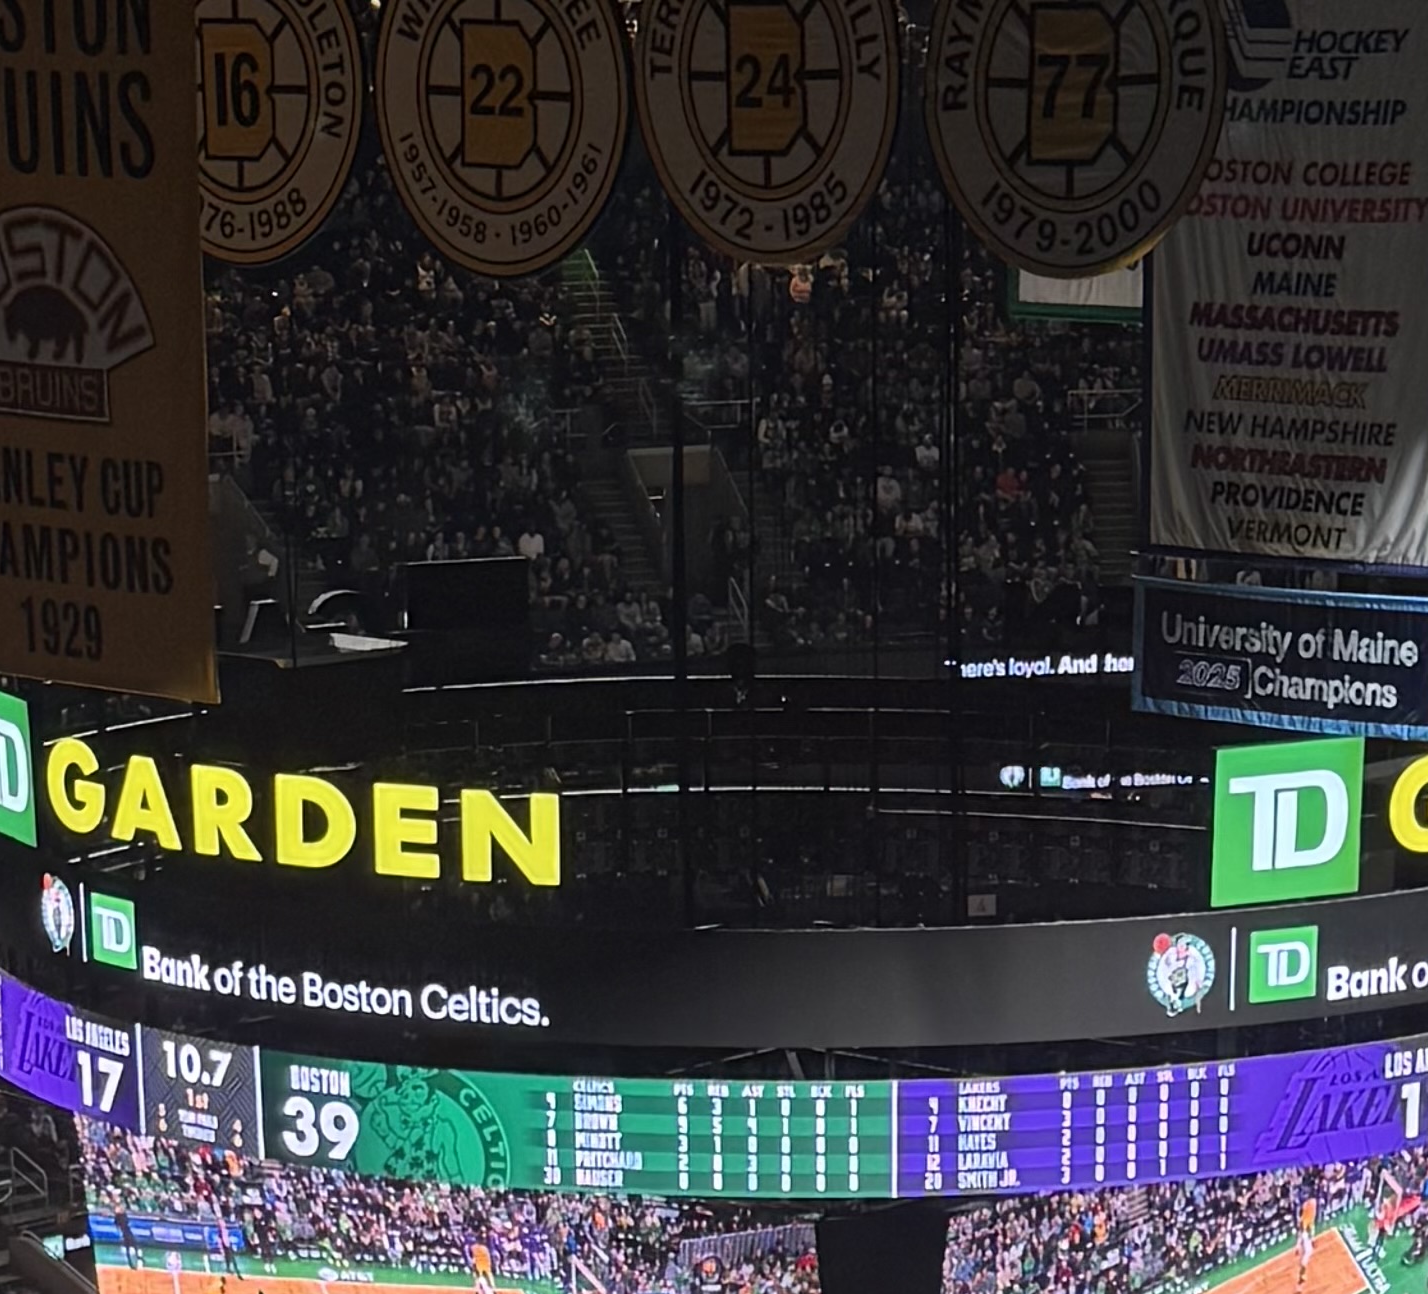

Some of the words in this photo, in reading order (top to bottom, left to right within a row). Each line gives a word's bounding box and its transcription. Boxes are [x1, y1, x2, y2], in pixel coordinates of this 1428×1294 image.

[1292, 28, 1411, 55] HOCKEY
[214, 51, 260, 128] 16
[469, 63, 525, 118] 22
[733, 52, 796, 109] 24
[1037, 53, 1111, 121] 77
[1286, 55, 1360, 81] EAST
[1203, 158, 1293, 186] OSTON
[1303, 160, 1413, 187] COLLEGE
[980, 178, 1164, 257] 1979-2000
[1246, 231, 1347, 260] UCONN
[1251, 270, 1338, 298] MAINE
[1189, 300, 1401, 338] MASSACHUSETTS
[1197, 336, 1285, 368] UMASS
[1291, 341, 1388, 374] LOWELL
[1211, 373, 1370, 409] MERRIMACK
[1183, 409, 1243, 436] NEW
[1250, 413, 1398, 448] HAMPSHIRE
[1190, 442, 1388, 484] NORTHEASTERN
[100, 457, 165, 520] CUP
[1209, 480, 1366, 517] PROVIDENCE
[1226, 516, 1348, 551] VERMONT
[22, 595, 105, 662] 1929
[1161, 609, 1293, 664] University
[1297, 627, 1328, 658] of
[1331, 627, 1421, 668] Maine
[1008, 656, 1056, 679] loyal.
[1057, 653, 1098, 675] And
[1175, 658, 1242, 692] 2025
[1252, 664, 1400, 711] Champions
[45, 736, 562, 887] GARDEN
[1228, 768, 1350, 873] TD
[94, 906, 132, 956] TD
[141, 945, 212, 992] Bank
[212, 960, 245, 995] of
[247, 963, 297, 1004] the
[303, 971, 414, 1019] Boston
[420, 983, 550, 1029] Celtics.
[1256, 939, 1312, 988] TD
[1325, 956, 1408, 1002] Bank
[76, 1050, 125, 1114] 17
[162, 1039, 233, 1088] 10.7
[289, 1064, 352, 1099] BOSTON
[1383, 1051, 1413, 1079] LOS
[282, 1094, 360, 1162] 39
